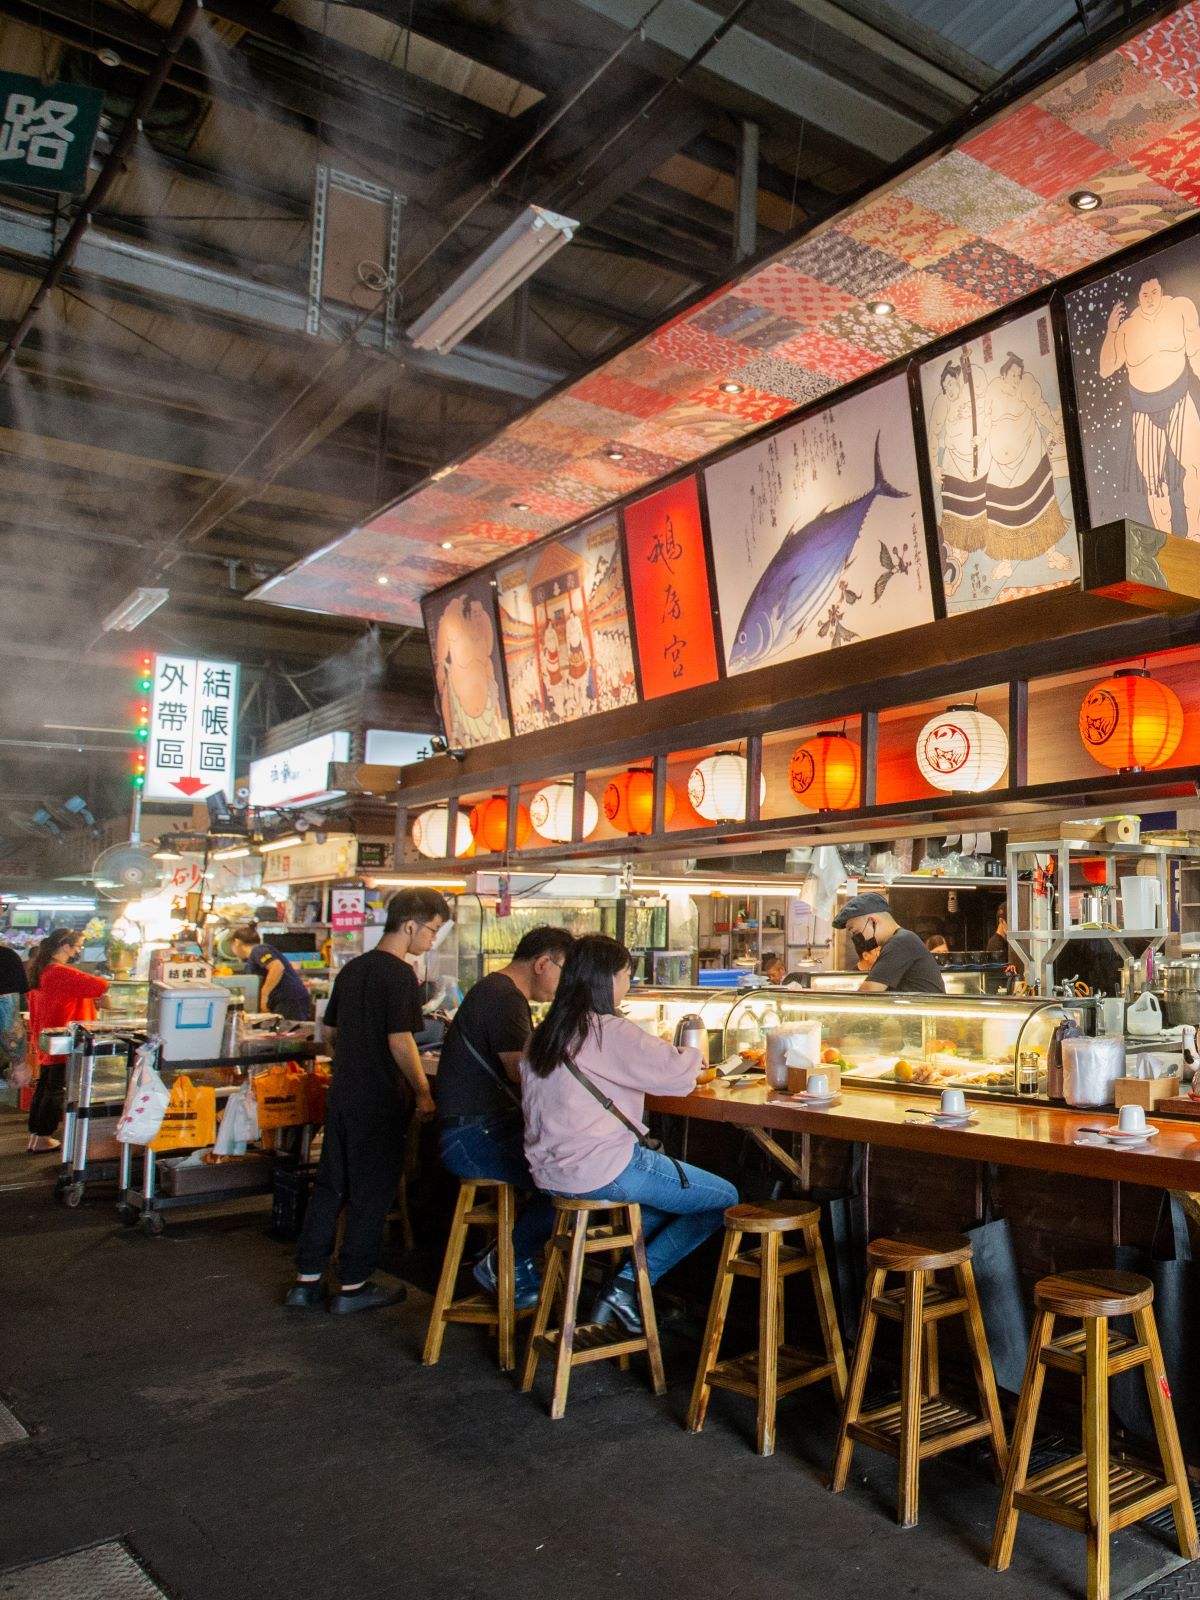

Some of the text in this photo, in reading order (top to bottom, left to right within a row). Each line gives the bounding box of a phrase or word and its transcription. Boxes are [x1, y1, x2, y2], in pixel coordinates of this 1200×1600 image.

[0, 93, 78, 170] 路
[157, 663, 188, 769] 外帶區
[200, 667, 231, 772] 結帳區
